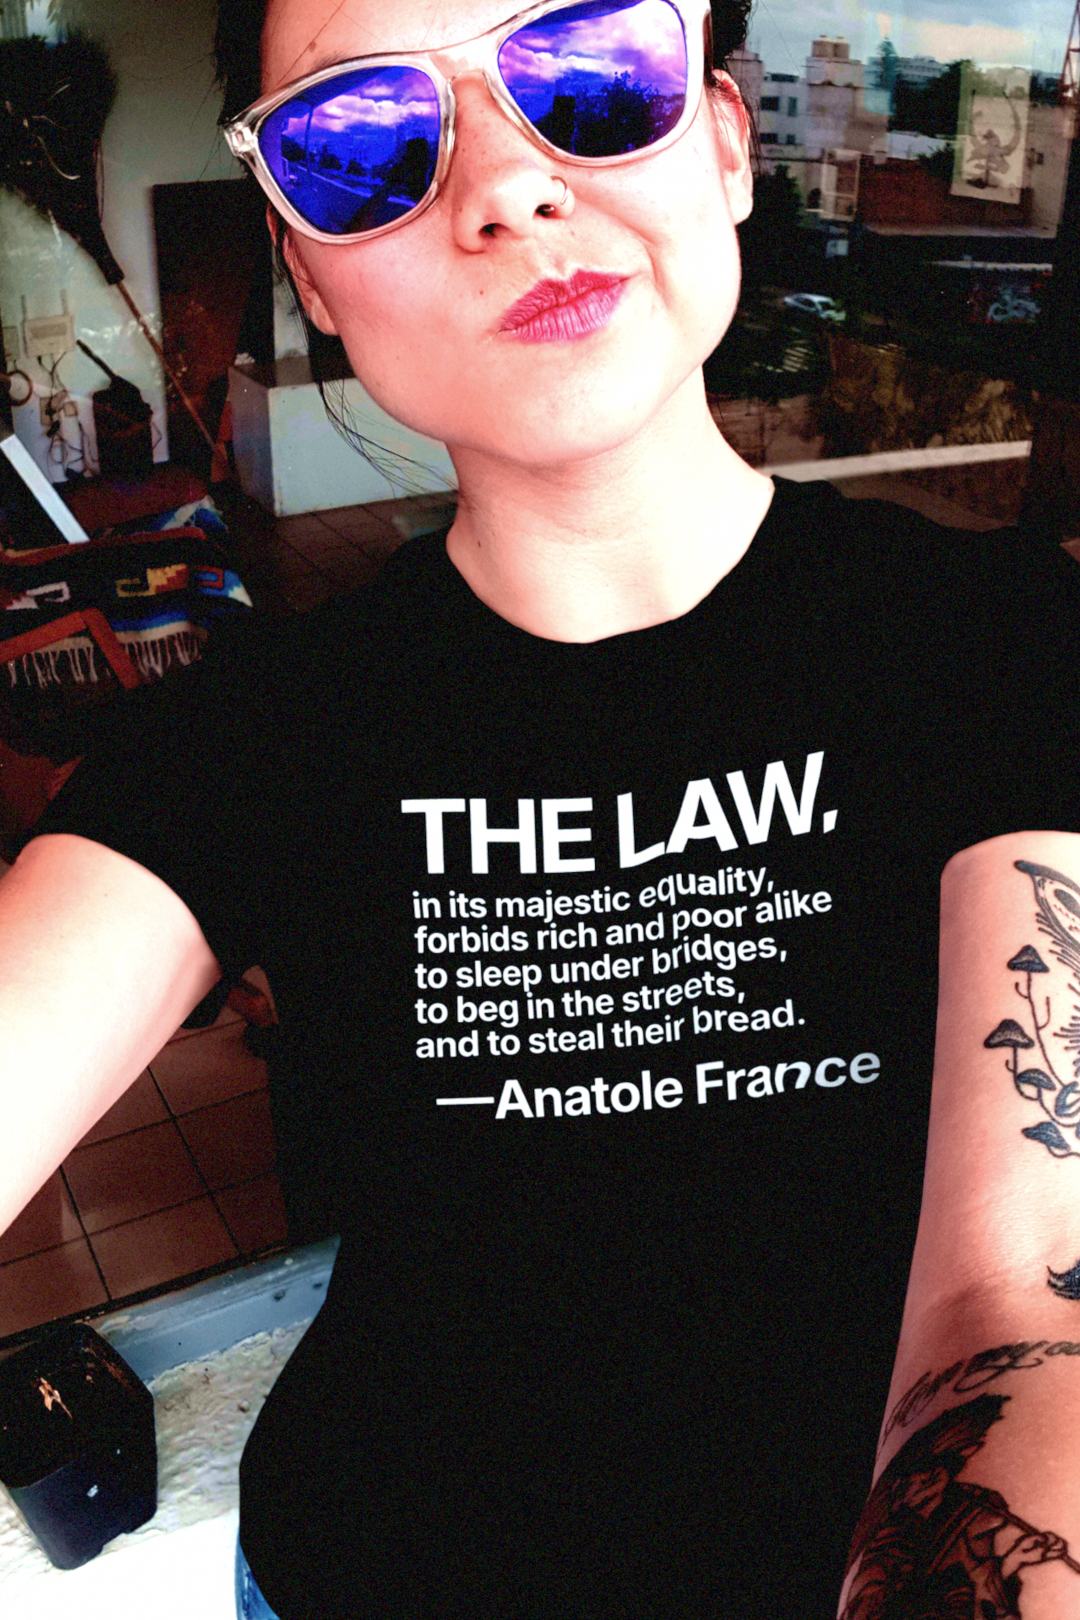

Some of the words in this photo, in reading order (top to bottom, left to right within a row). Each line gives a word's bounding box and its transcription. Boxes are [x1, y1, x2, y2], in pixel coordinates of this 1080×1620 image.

[401, 798, 595, 874] THE
[413, 891, 441, 918] in
[449, 890, 487, 918] its
[496, 886, 630, 923] majestic
[639, 867, 773, 907] equality,
[414, 924, 529, 953] forbids
[537, 922, 597, 950] rich
[606, 912, 664, 945] and
[673, 906, 747, 939] poor
[756, 890, 832, 923] alike
[415, 964, 447, 989] to
[456, 960, 542, 998] sleep
[551, 954, 644, 983] under
[652, 934, 786, 974] bridges,
[415, 999, 448, 1024] to
[457, 996, 519, 1028] beg
[527, 991, 554, 1019] in
[561, 990, 614, 1017] the
[623, 971, 744, 1012] streets,
[416, 1030, 479, 1058] and
[487, 1031, 520, 1055] to
[529, 1023, 604, 1053] steal
[611, 1015, 684, 1047] their
[693, 999, 805, 1034] bread.
[696, 1053, 880, 1104] France
